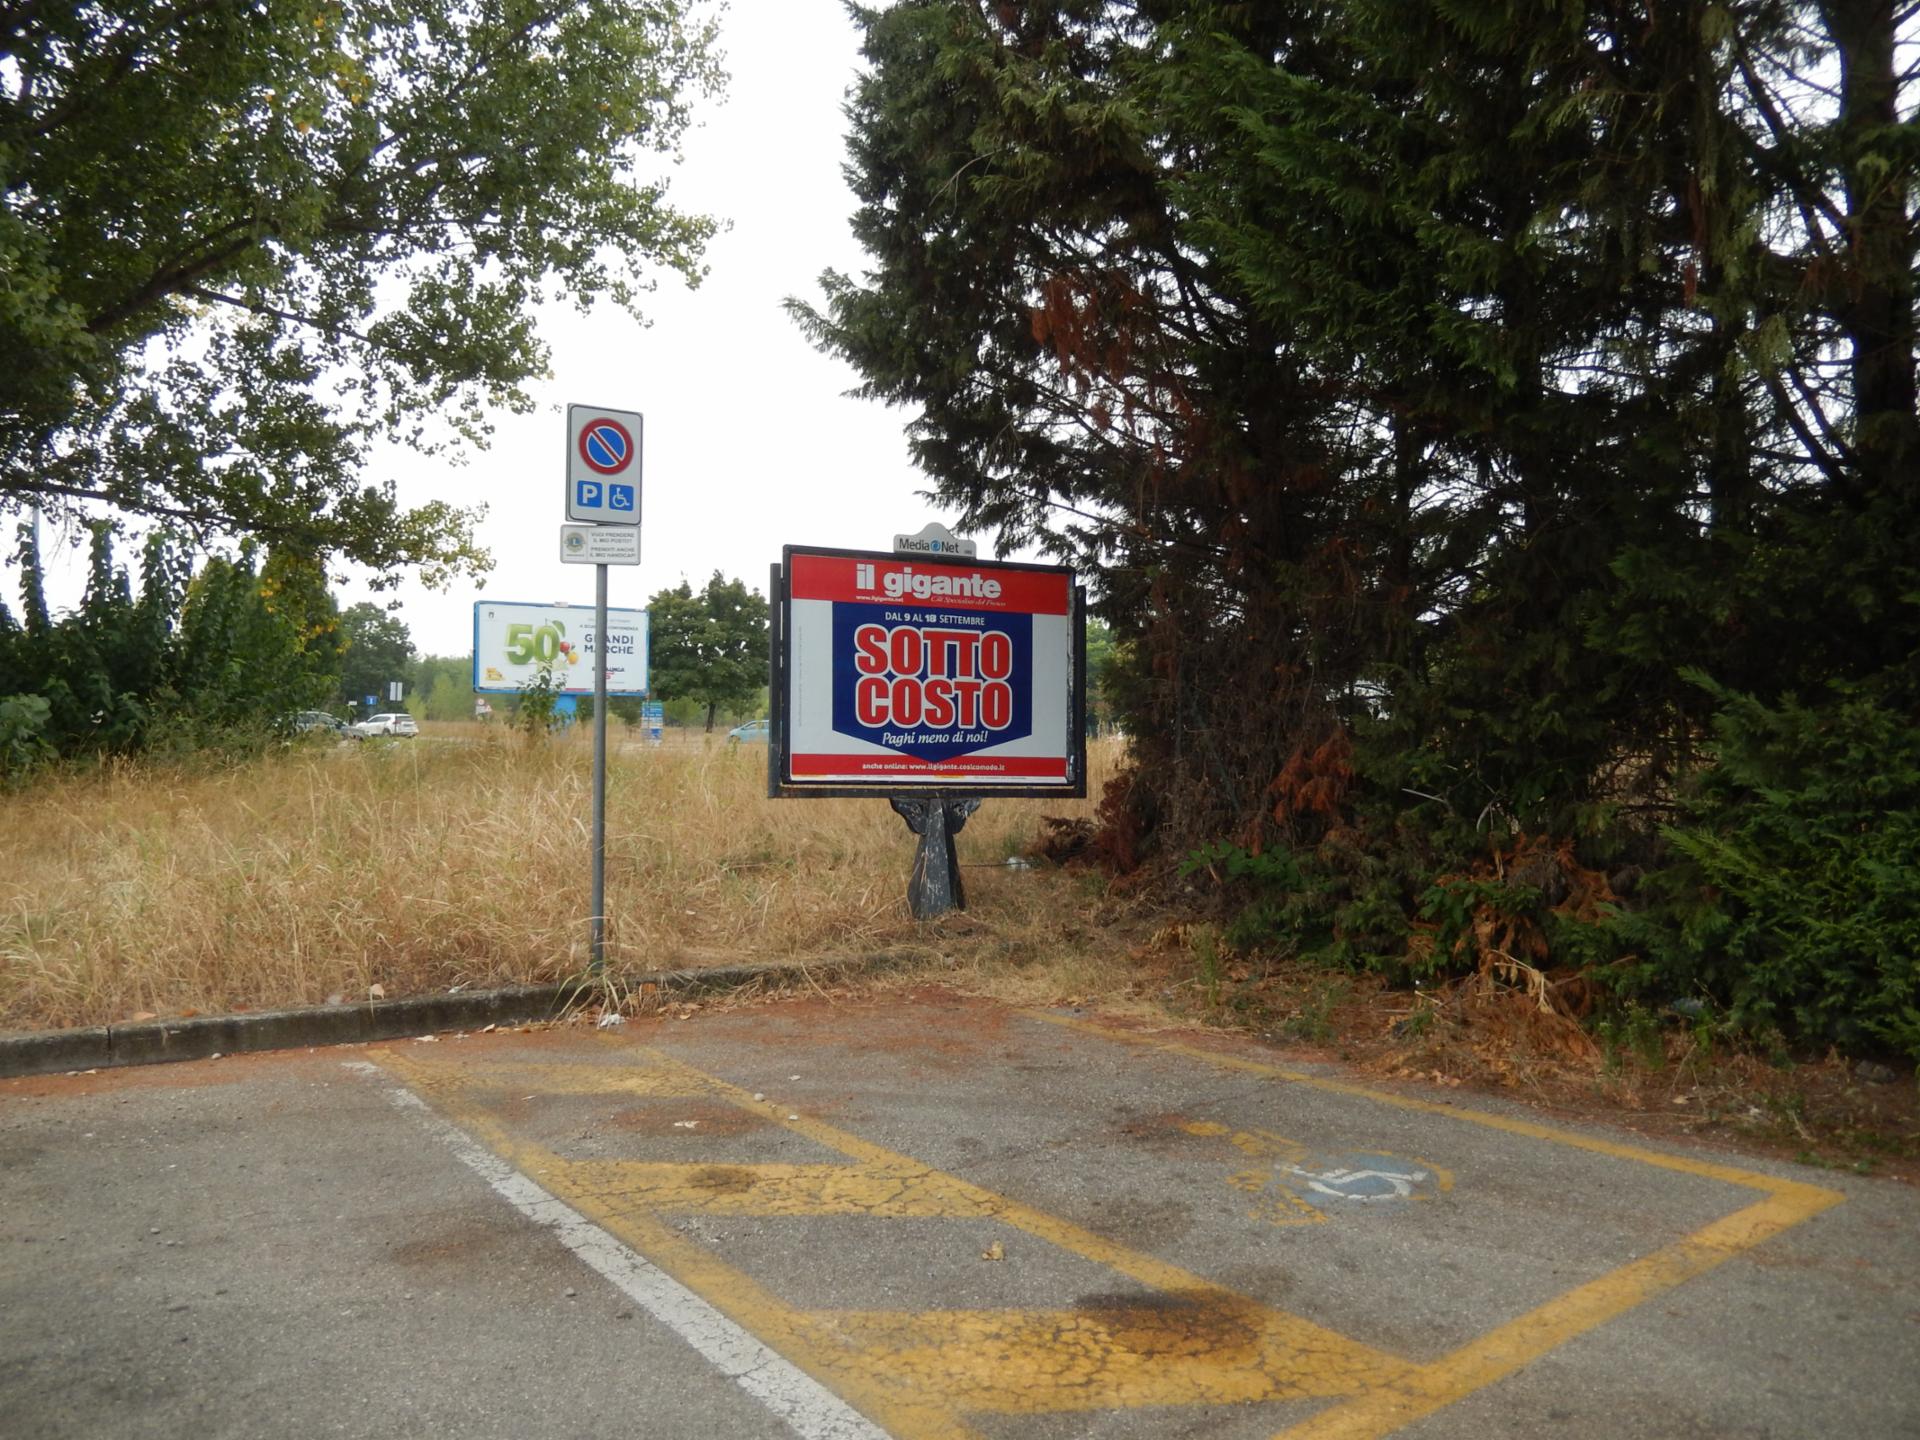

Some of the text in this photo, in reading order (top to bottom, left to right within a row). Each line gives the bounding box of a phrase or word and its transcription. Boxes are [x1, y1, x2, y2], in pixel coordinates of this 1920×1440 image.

[582, 484, 598, 504] P
[900, 538, 929, 551] Media
[941, 541, 959, 553] Net
[857, 564, 1002, 599] il gigante
[885, 611, 985, 626] DAL 9 AL 18 SETTEMBRE
[585, 633, 634, 645] GANDI
[584, 645, 634, 655] MRCHE
[855, 624, 1012, 681] SOTTO
[855, 676, 1012, 730] COSTO
[882, 730, 988, 747] Paghi meno di noi!
